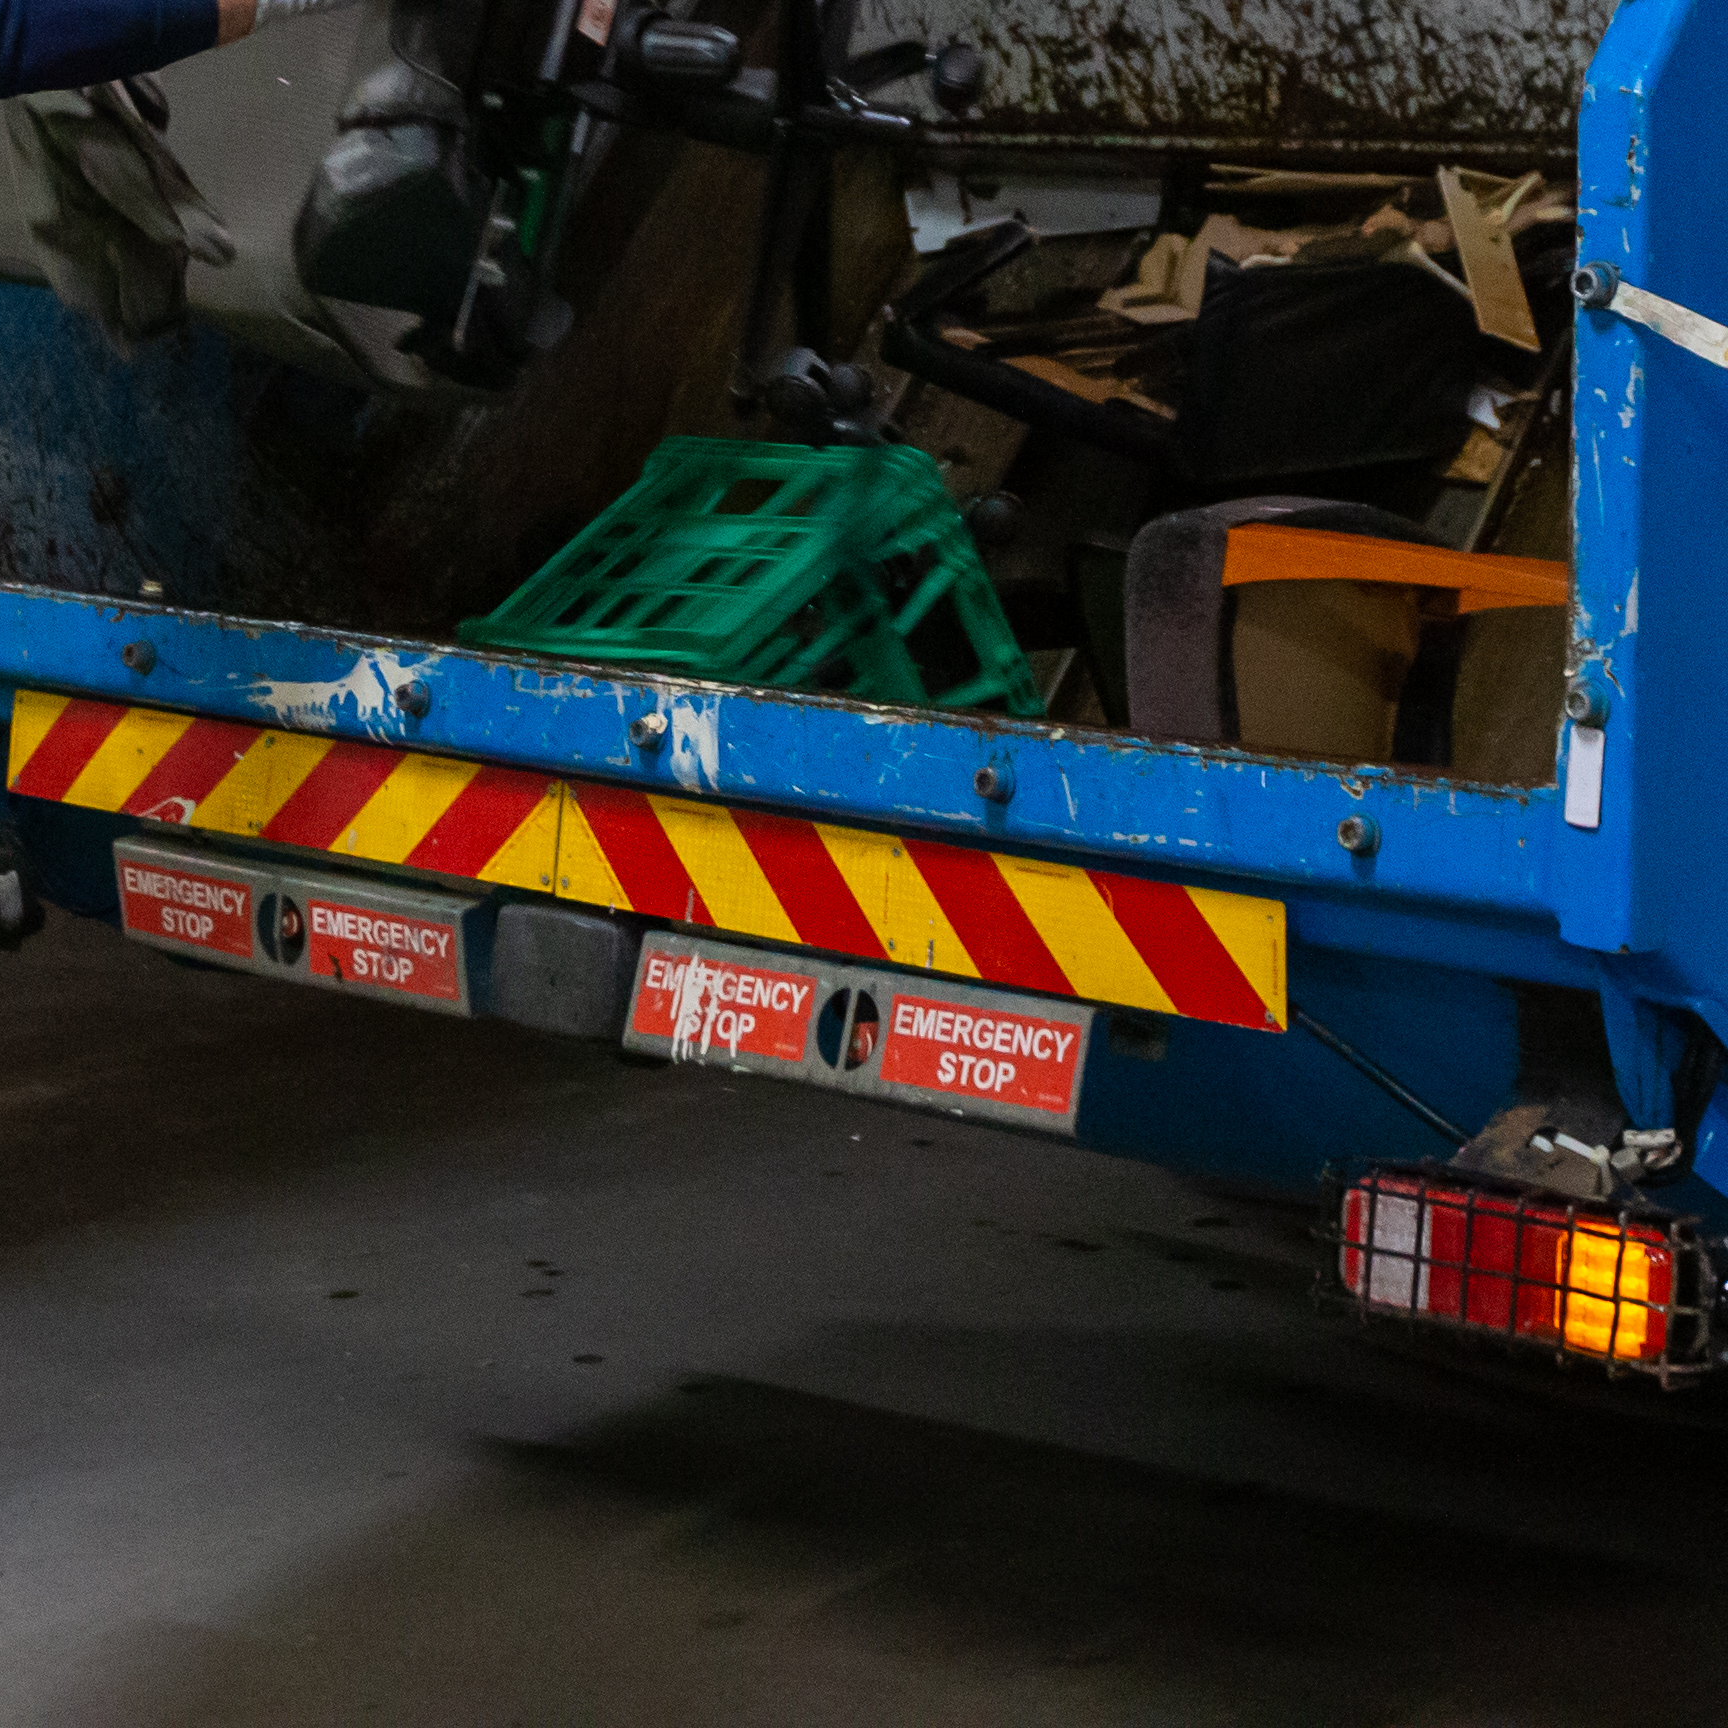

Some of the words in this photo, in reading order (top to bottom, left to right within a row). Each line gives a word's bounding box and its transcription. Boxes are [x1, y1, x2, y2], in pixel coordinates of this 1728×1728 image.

[123, 866, 247, 917] EMERGENCY
[161, 905, 215, 942] STOP
[310, 906, 450, 959] EMERGENCY
[352, 948, 415, 984] STOP
[893, 1004, 1075, 1064] EMERGENCY
[936, 1054, 1017, 1094] STOP
